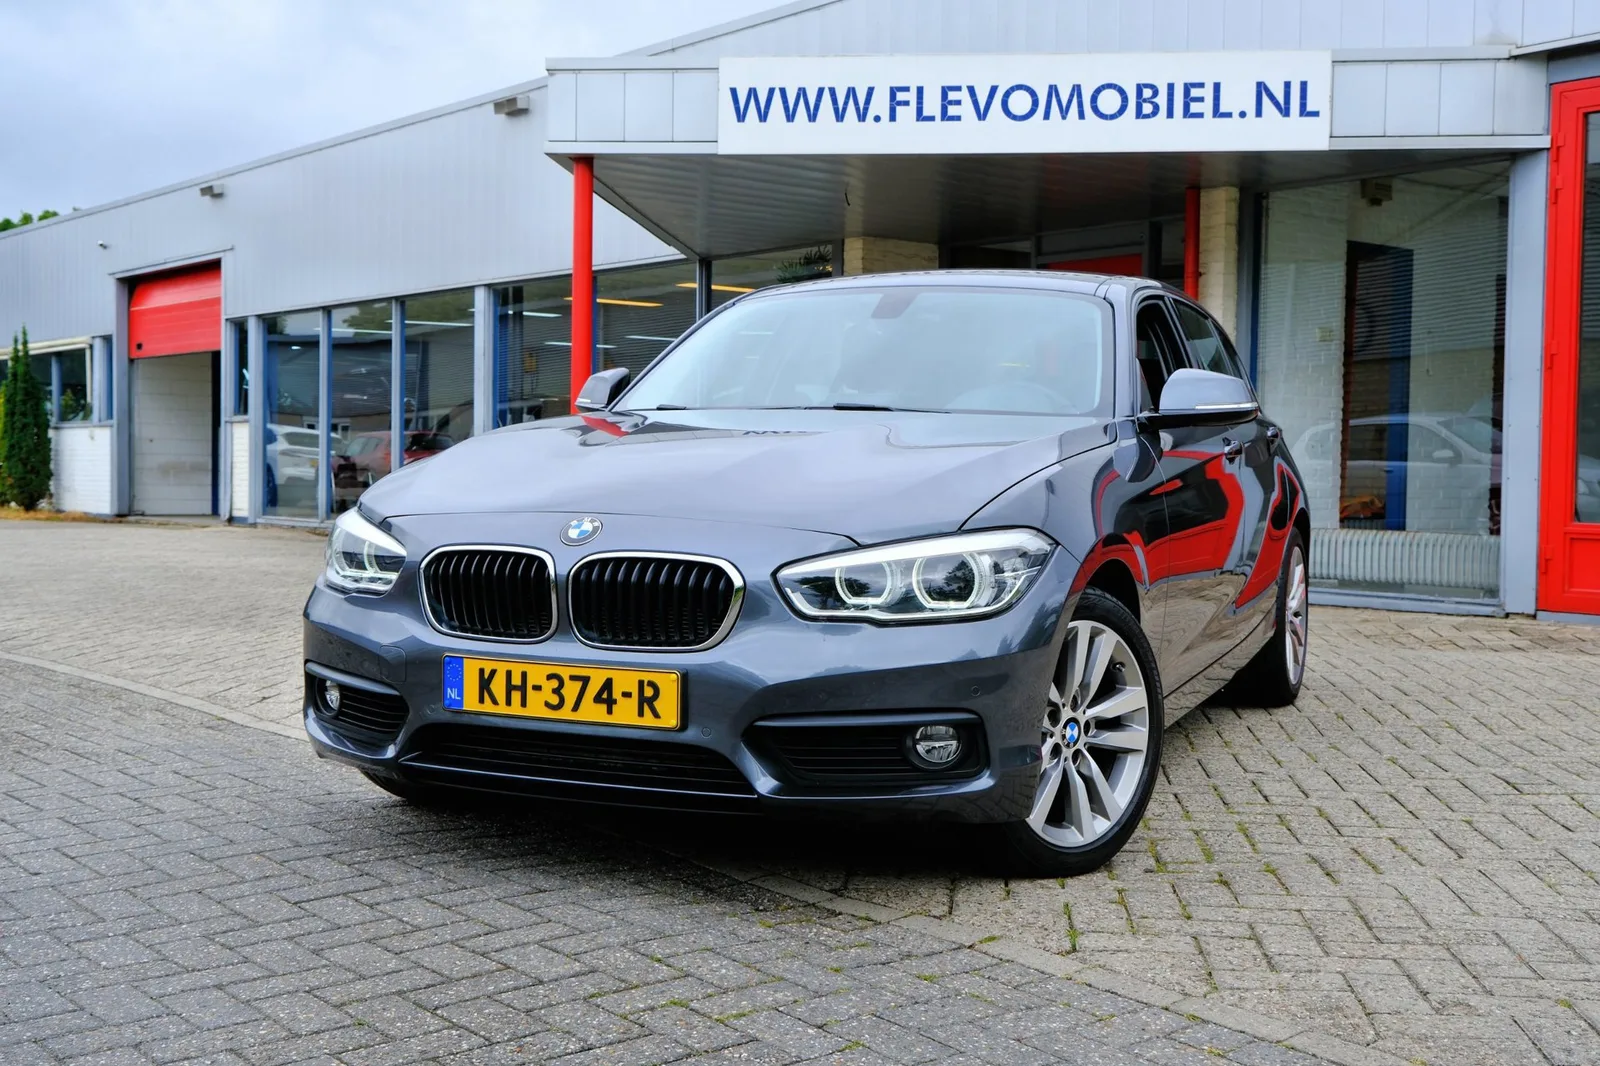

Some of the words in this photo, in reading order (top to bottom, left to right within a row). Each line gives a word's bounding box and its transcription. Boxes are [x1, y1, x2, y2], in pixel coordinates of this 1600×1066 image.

[729, 80, 1320, 123] WWW.FLEVOMOBIEL.NL
[447, 688, 461, 700] NL
[478, 667, 661, 719] KH-374-R
